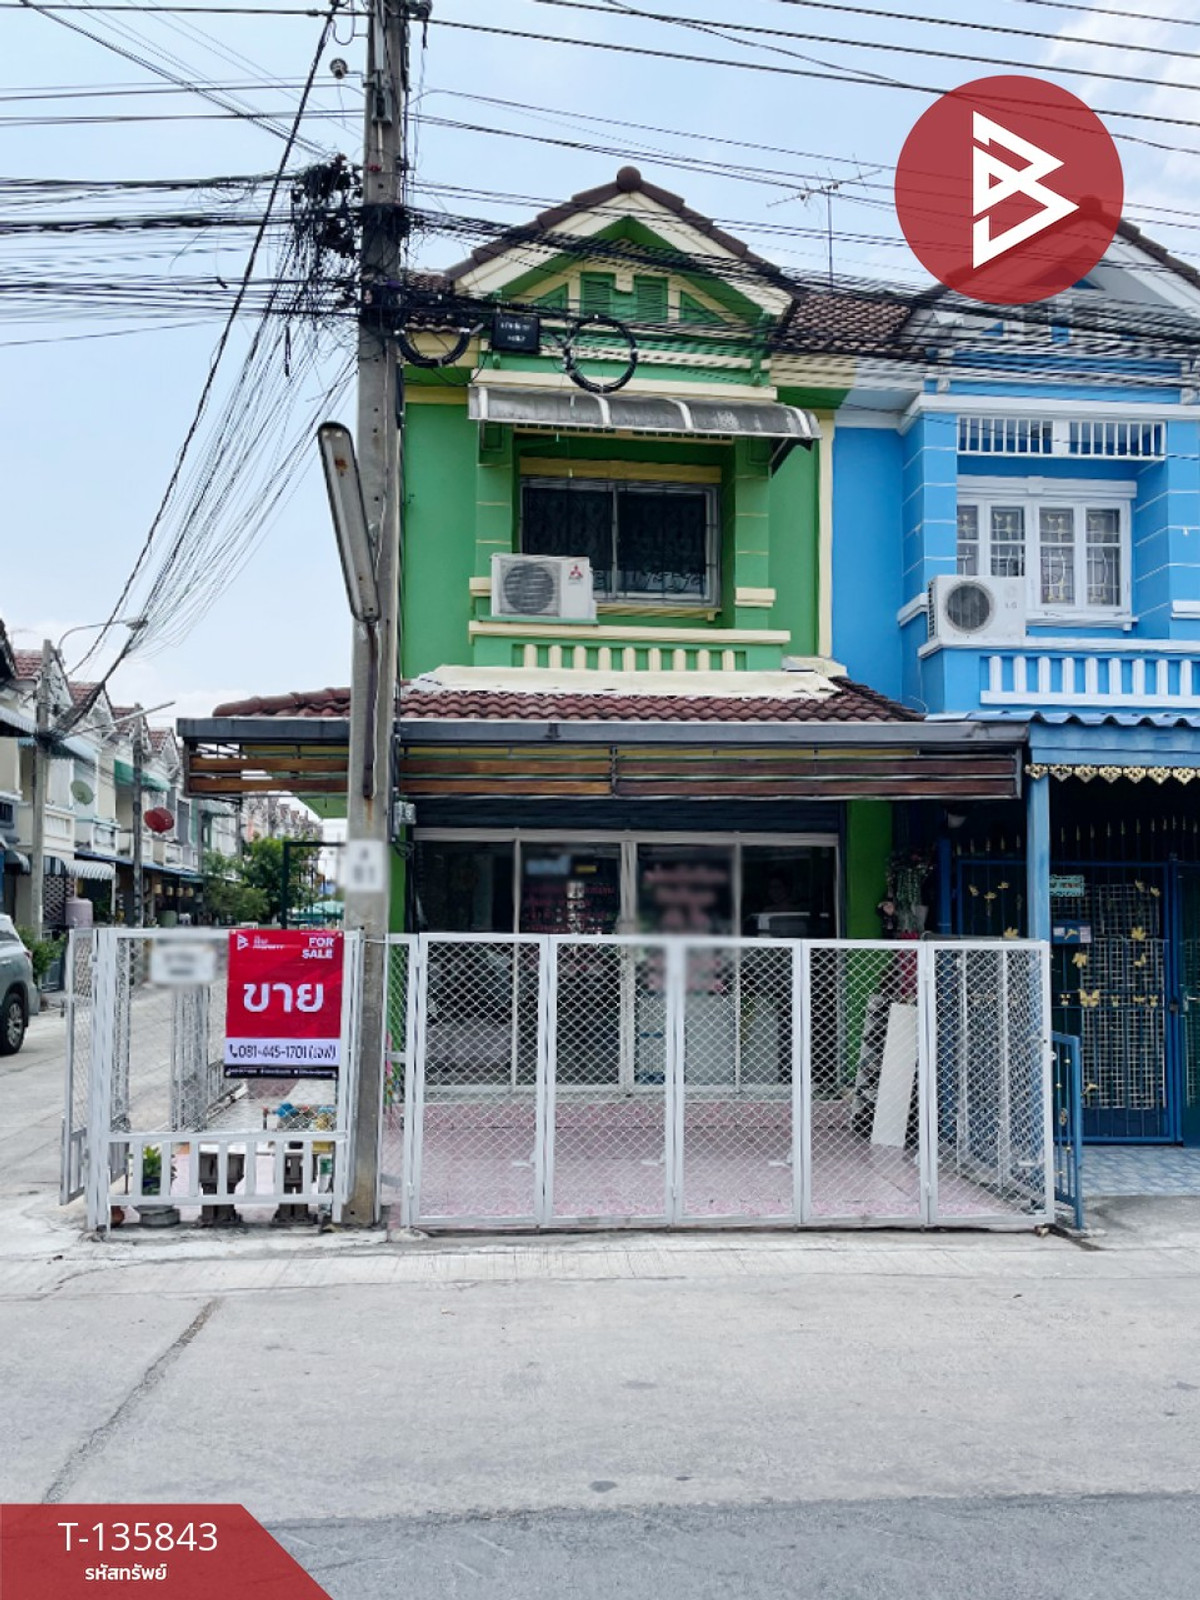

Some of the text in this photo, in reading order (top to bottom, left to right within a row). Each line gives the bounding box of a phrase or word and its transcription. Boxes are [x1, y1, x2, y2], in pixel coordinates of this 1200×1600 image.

[308, 937, 335, 948] FOR
[302, 949, 334, 959] SALE
[243, 983, 324, 1013] ขาย
